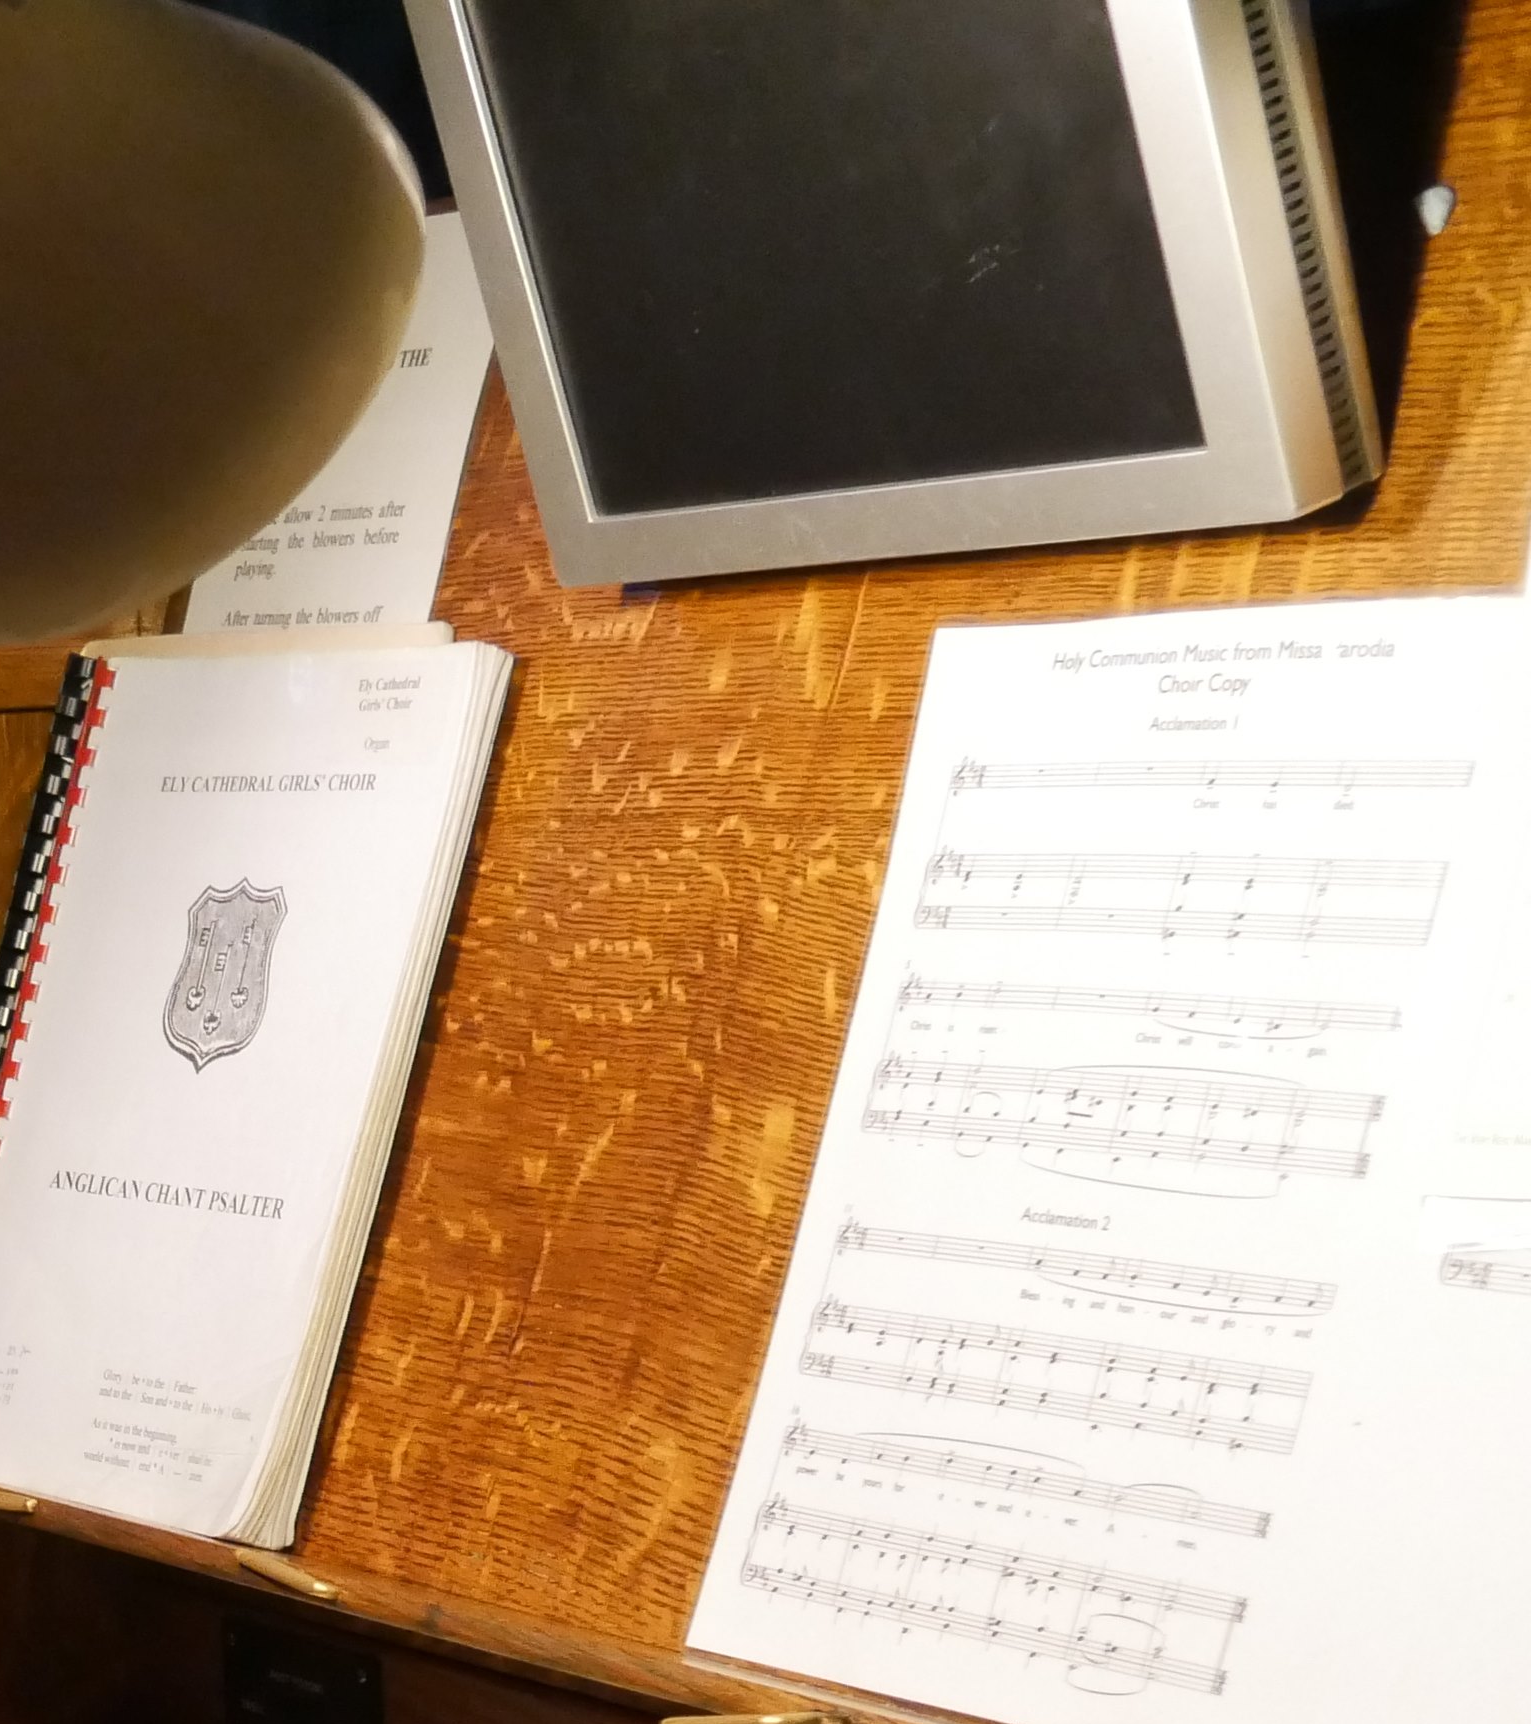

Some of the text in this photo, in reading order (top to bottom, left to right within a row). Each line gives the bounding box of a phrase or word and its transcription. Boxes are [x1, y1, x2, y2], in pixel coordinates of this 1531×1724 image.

[400, 347, 433, 367] THE
[284, 500, 406, 524] allow 2 minutes after
[288, 532, 305, 549] the
[312, 532, 355, 547] blowers
[363, 528, 400, 545] before
[234, 561, 276, 581] playing.
[222, 605, 384, 629] After turning the blowers off
[1052, 638, 1396, 673] Holy Communion Music from Missa arodia
[359, 676, 421, 693] Ely Cathedral
[1158, 672, 1251, 696] Choir Copy
[1149, 716, 1227, 732] Acclamation
[160, 772, 377, 793] ELY CATHEDRAL GIRLS' CHOIR
[49, 1170, 284, 1220] ANGLICAN CHANT PSALTER
[1020, 1207, 1110, 1231] Acclamation 2
